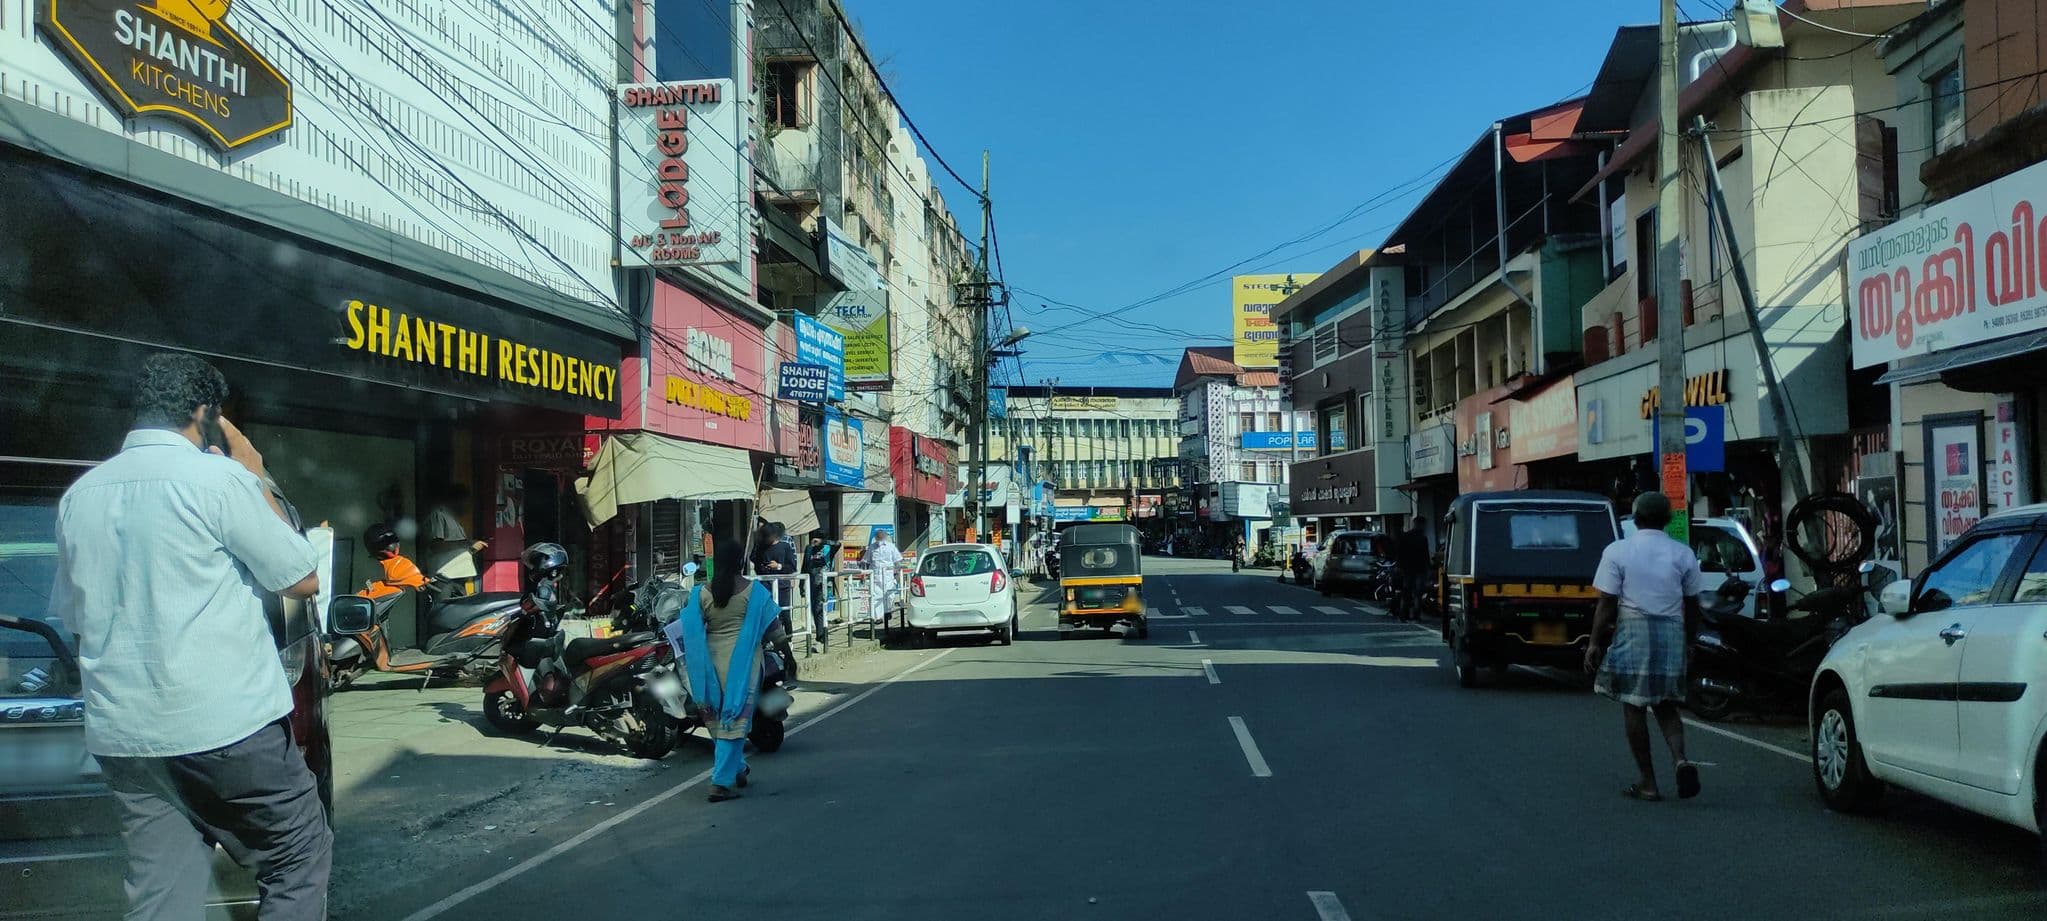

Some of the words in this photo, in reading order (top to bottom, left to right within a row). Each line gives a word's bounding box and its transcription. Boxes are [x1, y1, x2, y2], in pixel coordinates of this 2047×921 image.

[114, 9, 247, 97] SHANTHI
[132, 57, 230, 118] KITCHENS
[624, 82, 721, 107] SHANTHI
[656, 107, 690, 229] LODGE
[631, 234, 653, 248] A/C
[656, 233, 667, 246] &
[652, 247, 701, 261] ROOMS
[835, 305, 866, 318] TECH
[347, 299, 489, 377] SHANTHI
[498, 338, 617, 402] RESIDENCY
[686, 325, 736, 381] ROYAL
[781, 376, 826, 390] LODGE
[782, 365, 827, 379] SHANTHI
[1640, 368, 1728, 420] GOWILL
[1268, 435, 1316, 446] POPLAR
